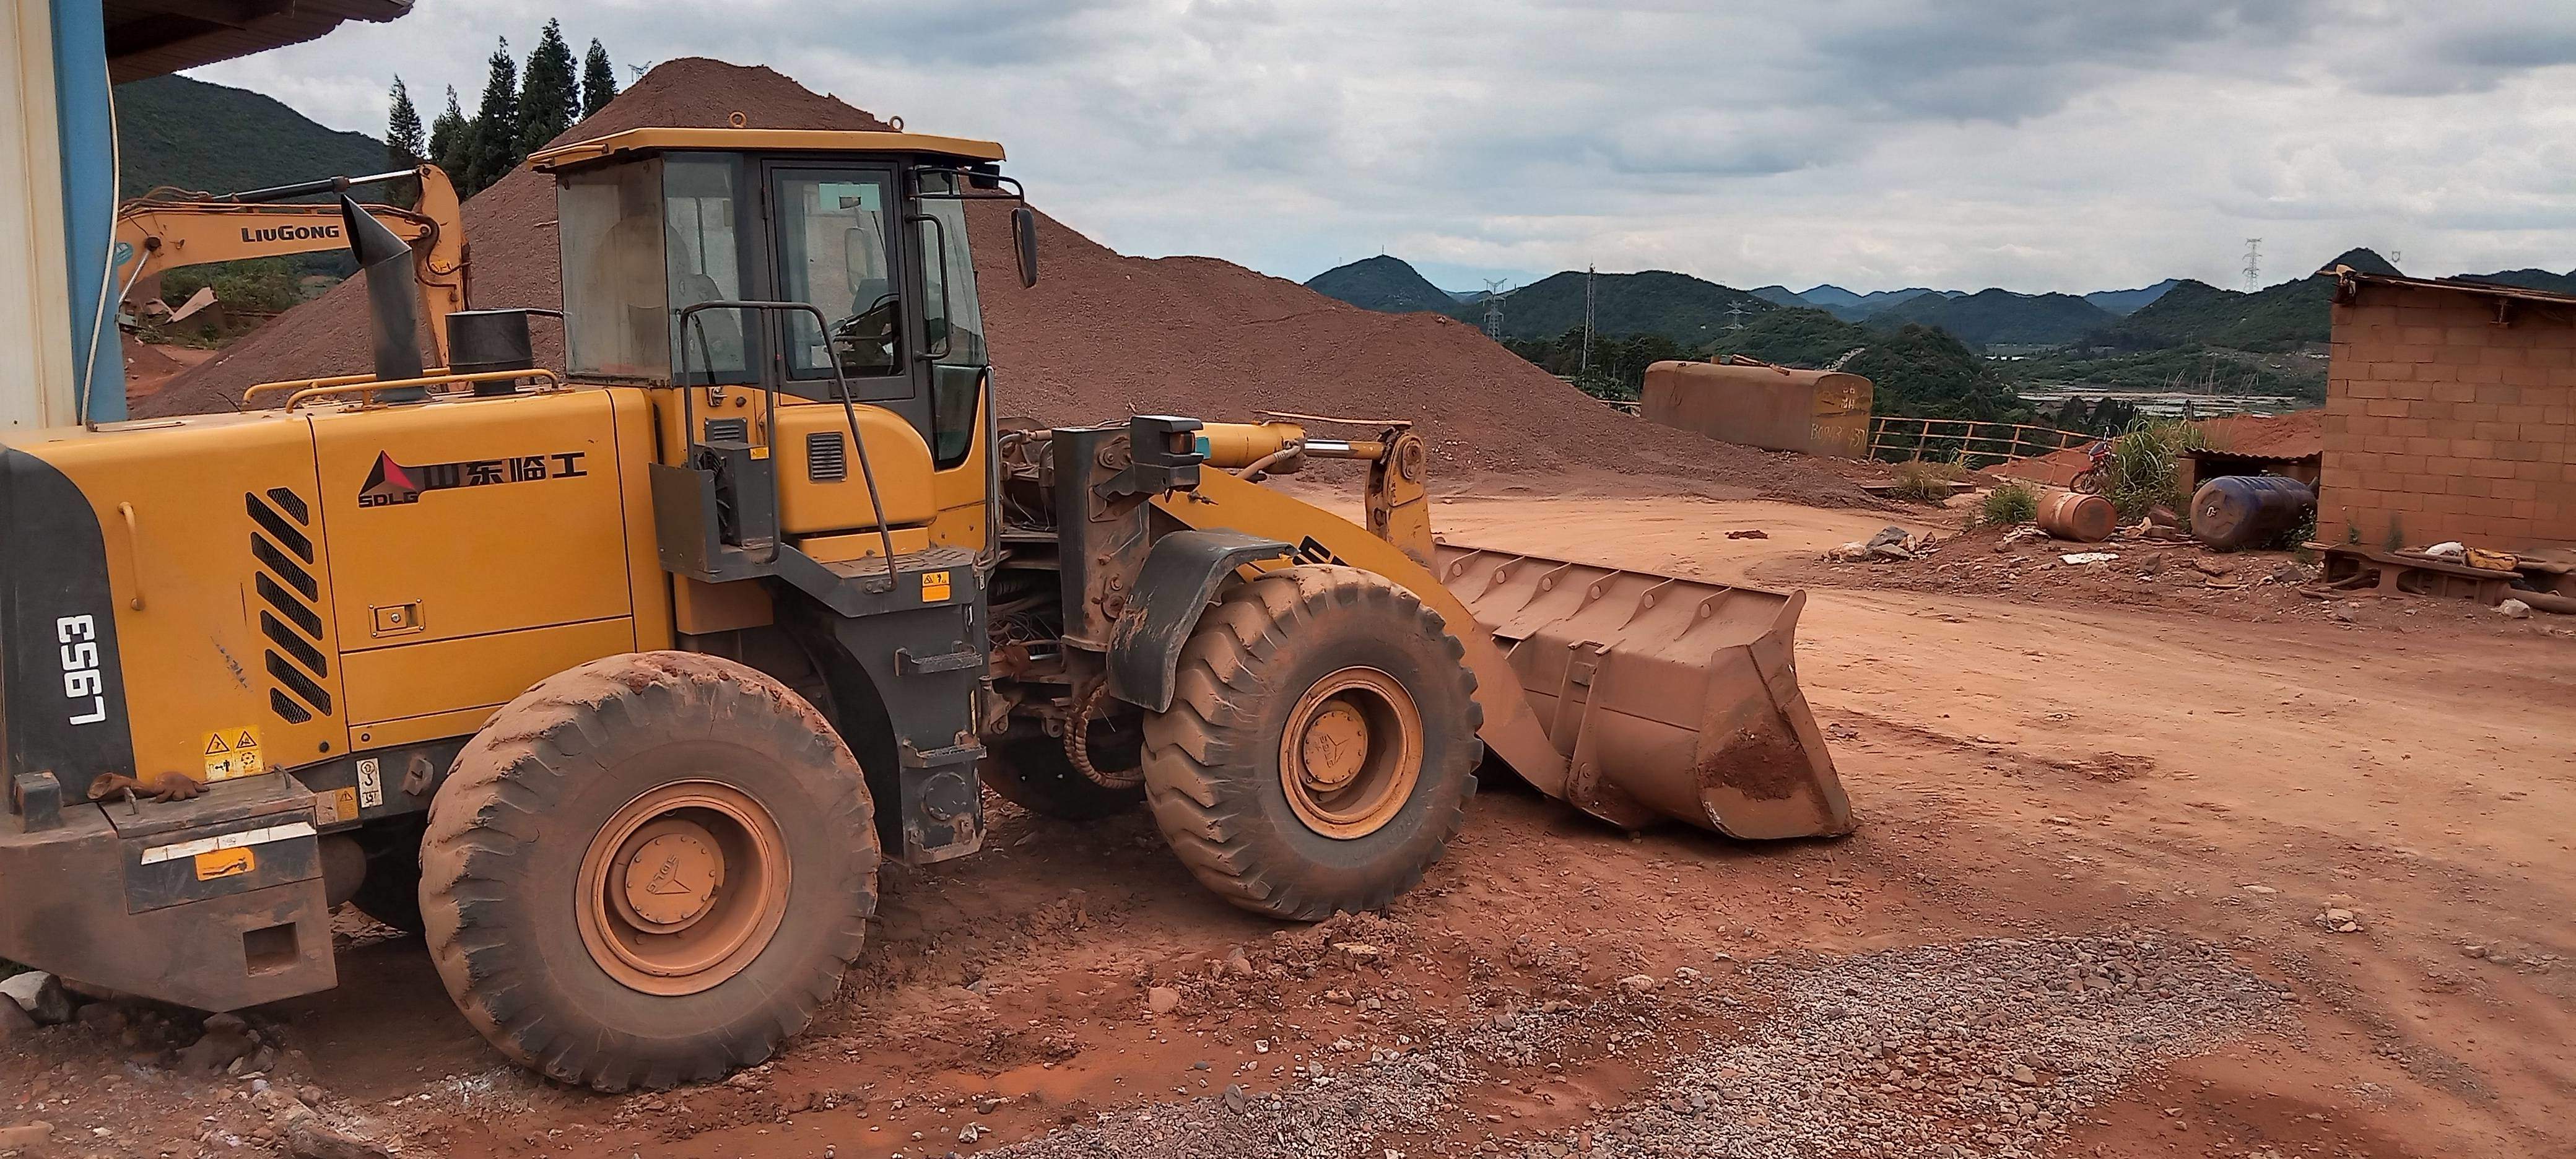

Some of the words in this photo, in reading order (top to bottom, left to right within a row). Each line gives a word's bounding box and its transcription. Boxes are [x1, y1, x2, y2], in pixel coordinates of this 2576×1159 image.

[424, 451, 588, 490] 山东临工
[359, 492, 419, 508] SDLG
[56, 614, 106, 725] L953
[646, 854, 679, 894] SDLG
